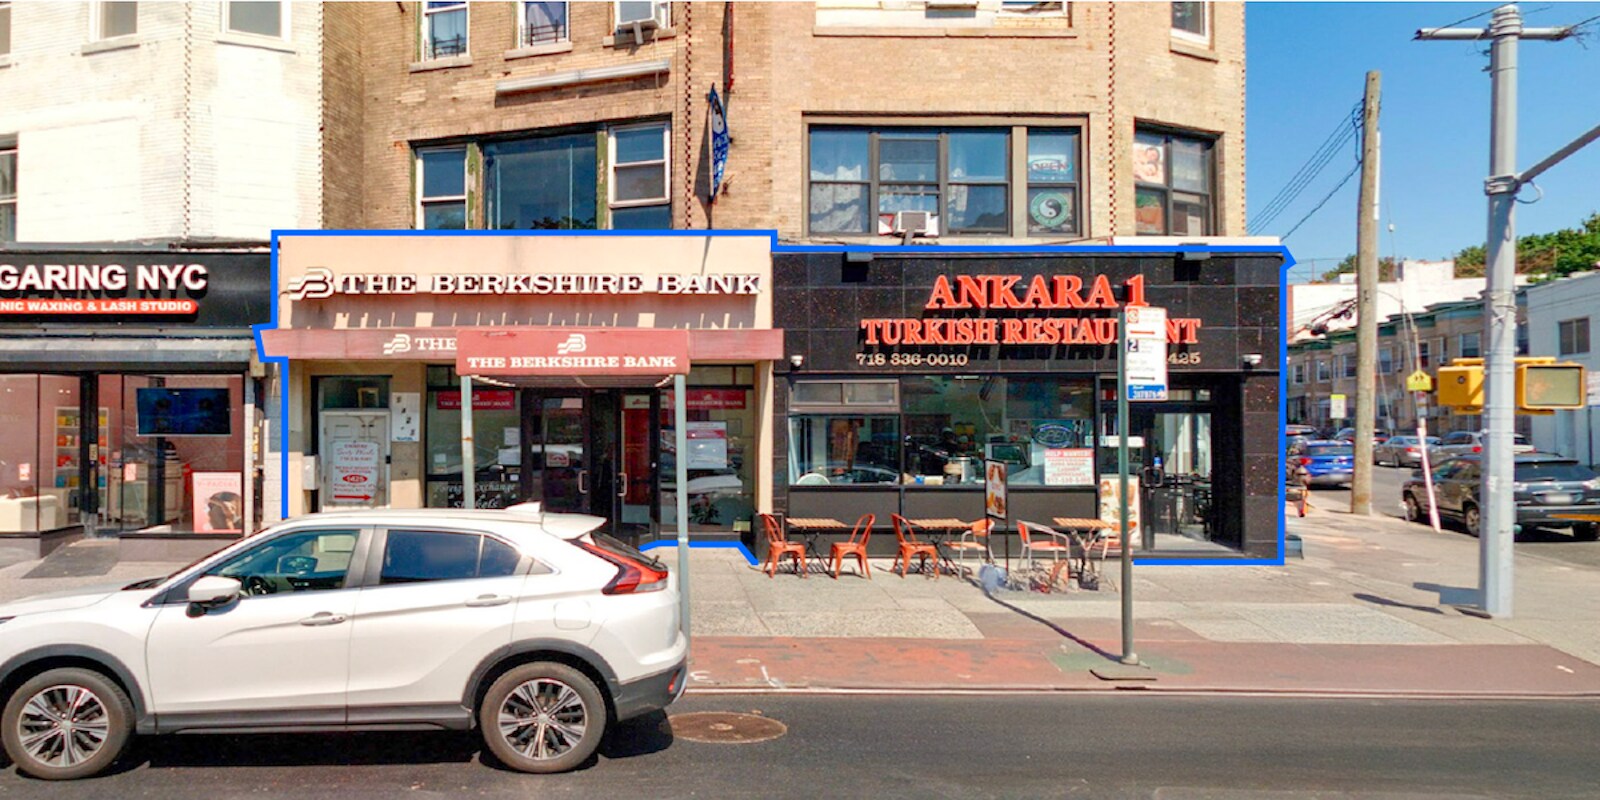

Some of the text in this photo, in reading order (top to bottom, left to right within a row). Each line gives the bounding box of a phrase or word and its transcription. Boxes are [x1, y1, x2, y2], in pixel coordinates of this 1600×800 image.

[0, 264, 207, 290] GARING NYC
[341, 273, 761, 295] THE BERKSHIRE BANK
[925, 274, 1149, 309] ANKARA 1
[0, 301, 192, 311] NIC WAXING & LASH STUDIO
[861, 318, 1202, 345] TURKISH RESTAUNT
[415, 338, 457, 350] THE
[1128, 339, 1137, 351] 2
[467, 356, 677, 368] THE BERKSHIRE BANK
[856, 353, 968, 366] 718 336-0010
